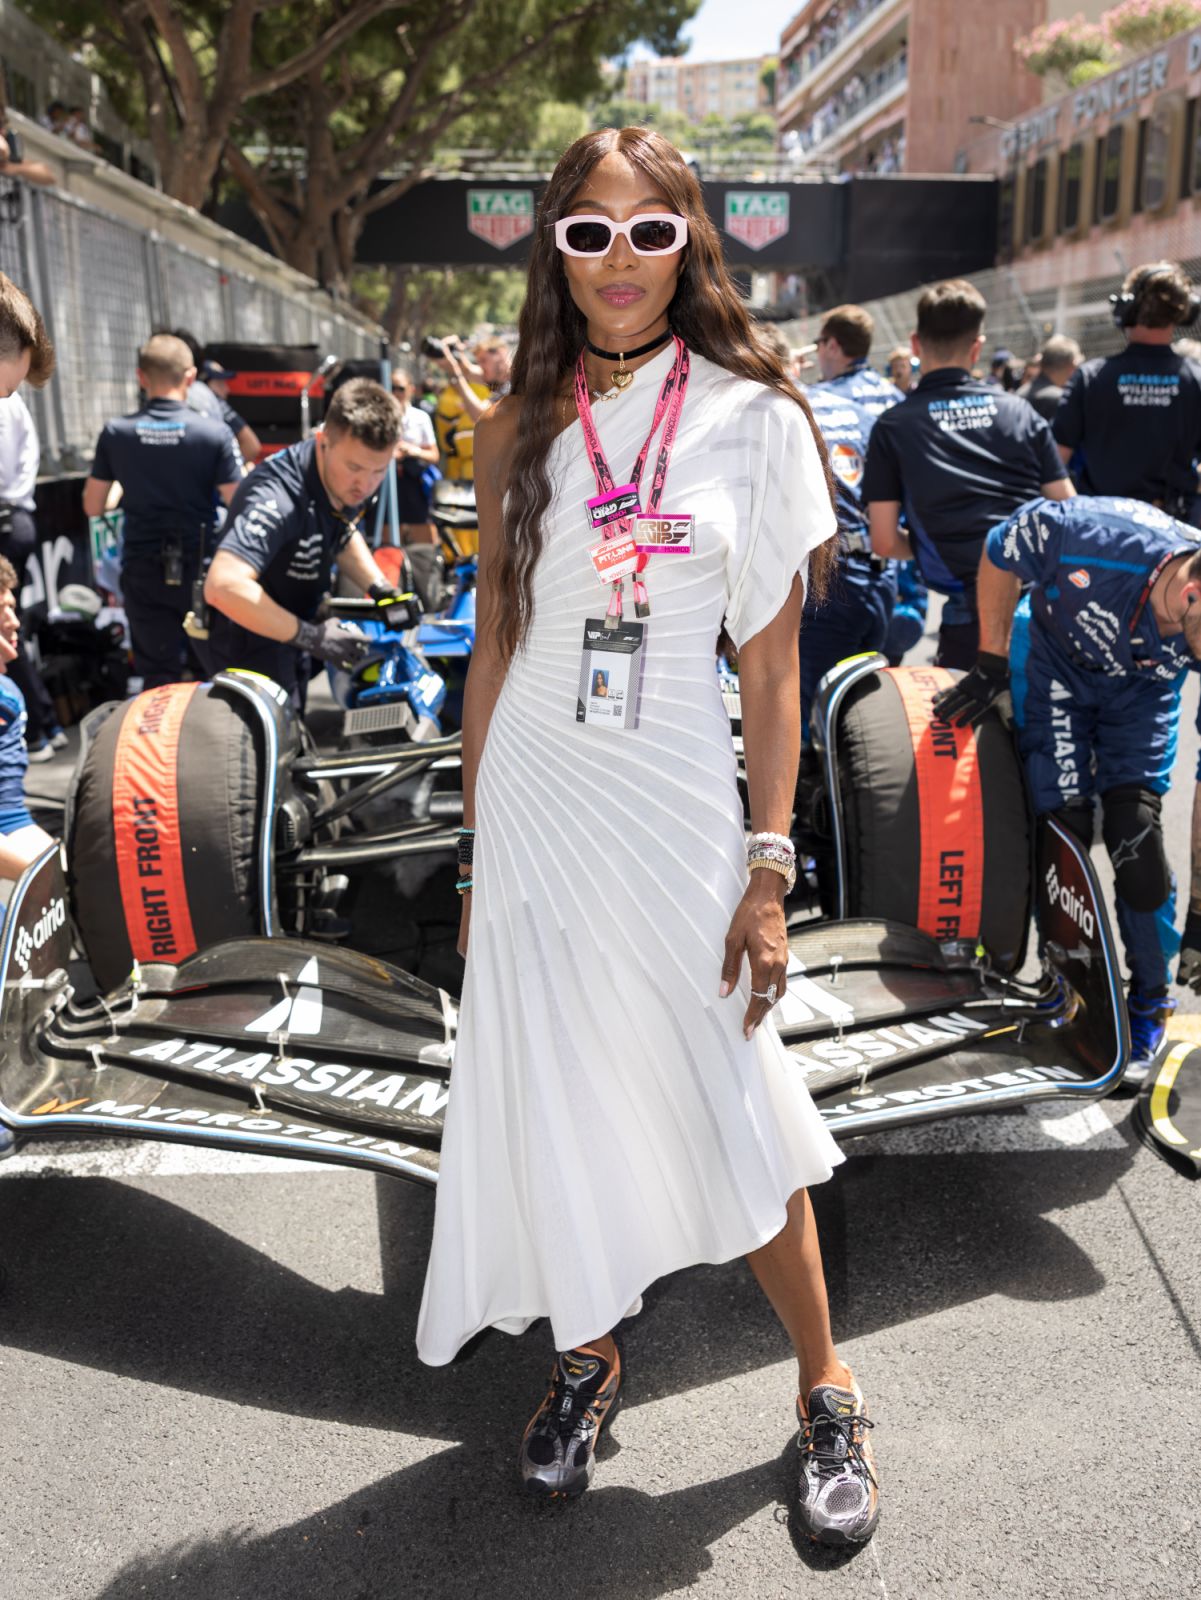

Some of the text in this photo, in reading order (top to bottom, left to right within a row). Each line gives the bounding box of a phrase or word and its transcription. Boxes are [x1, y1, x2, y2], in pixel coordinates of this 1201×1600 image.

[133, 796, 177, 956] RIGHT FRONT
[935, 851, 964, 942] LEFT FR
[32, 897, 66, 949] airia
[1059, 885, 1094, 939] airia
[790, 1011, 989, 1079] ASSIAN
[130, 1038, 450, 1117] ATLASSIAN
[820, 1065, 1084, 1120] YPROTEIN
[83, 1099, 420, 1158] MYPROTEIN
